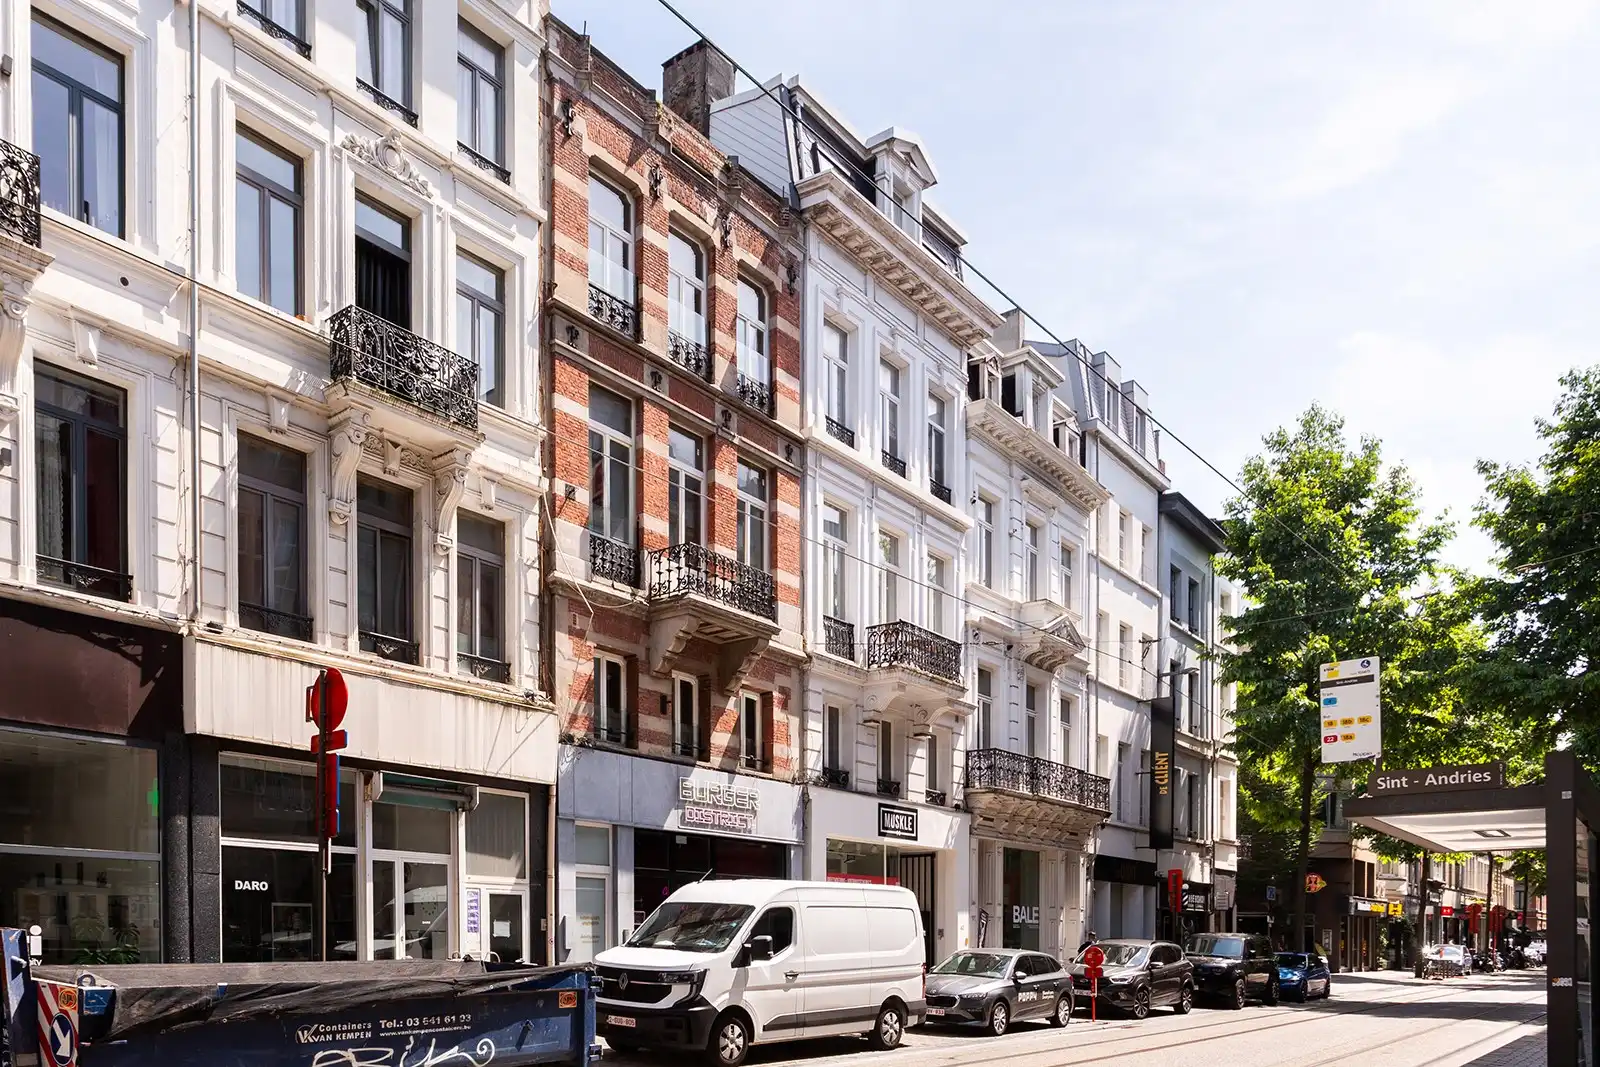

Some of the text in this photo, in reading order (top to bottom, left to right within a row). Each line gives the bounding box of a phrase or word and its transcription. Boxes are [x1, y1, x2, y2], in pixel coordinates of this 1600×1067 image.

[1155, 752, 1169, 795] DE CLIENT
[1376, 776, 1408, 790] Sint
[1424, 770, 1492, 786] Andries
[680, 777, 760, 811] BURGER
[685, 805, 755, 829] DISTRICT
[884, 812, 913, 831] MUSKLE
[234, 880, 269, 891] DARO
[1013, 905, 1039, 924] BALE
[319, 1022, 372, 1032] Containers
[380, 1019, 403, 1029] Tel.:
[406, 1018, 419, 1027] 03
[444, 1015, 456, 1024] 61
[312, 1031, 372, 1042] VAN KEMPEN
